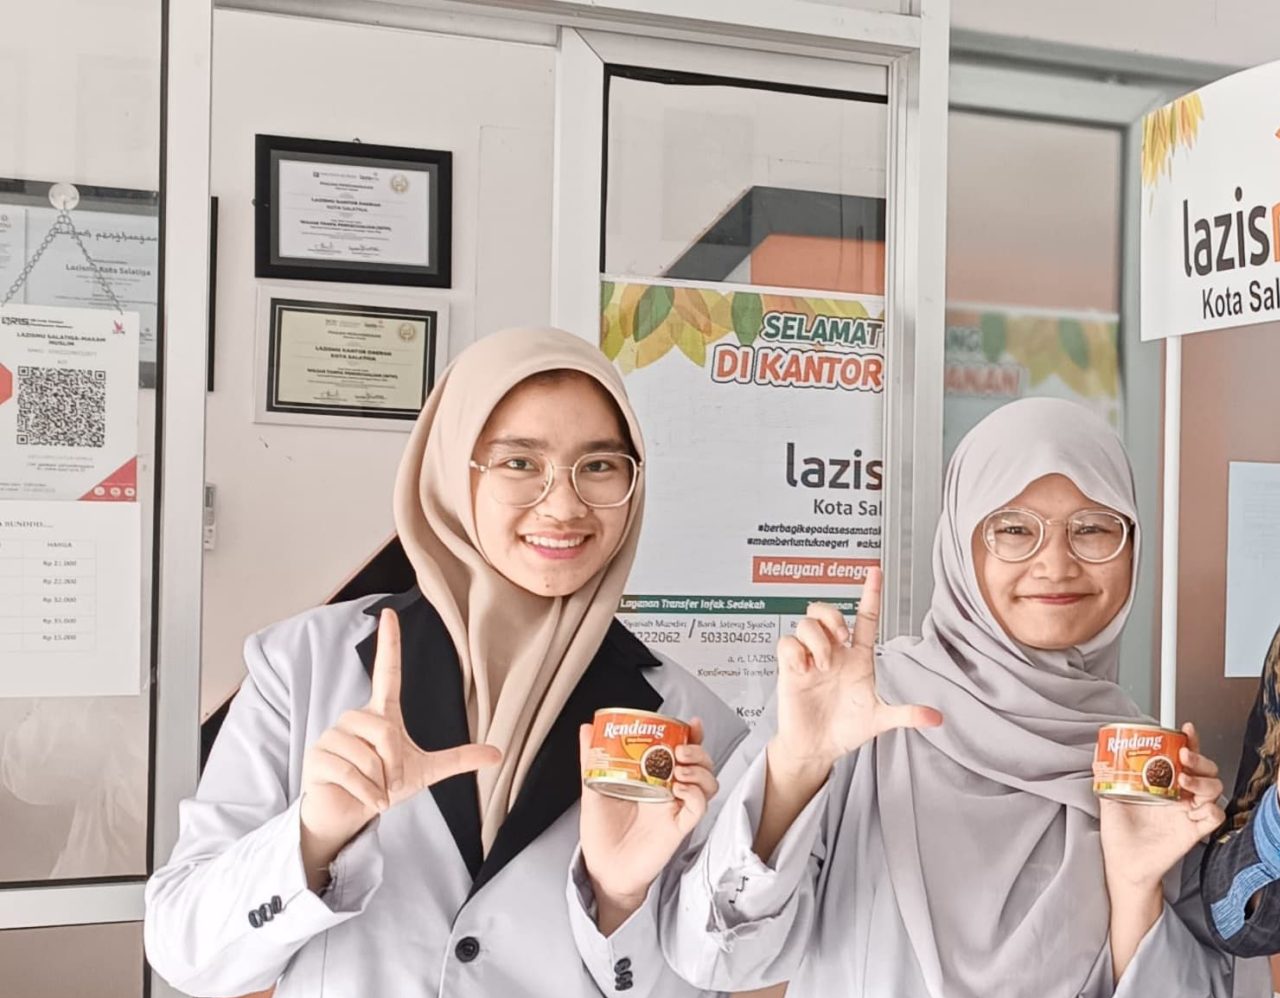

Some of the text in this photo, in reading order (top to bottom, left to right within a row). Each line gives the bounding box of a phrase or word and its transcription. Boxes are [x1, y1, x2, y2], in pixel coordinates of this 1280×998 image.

[1203, 287, 1243, 319] Kota
[763, 314, 883, 347] SELAMAT
[716, 349, 883, 387] DI KANTOR
[785, 442, 883, 491] lazis
[813, 499, 853, 515] Kota
[759, 561, 824, 579] Melayani
[662, 599, 699, 610] Transfer
[726, 599, 766, 609] Sedekah
[700, 631, 772, 643] 5033040252
[736, 706, 765, 719] Kese
[603, 719, 666, 739] Rendang
[1107, 733, 1164, 754] Rendang
